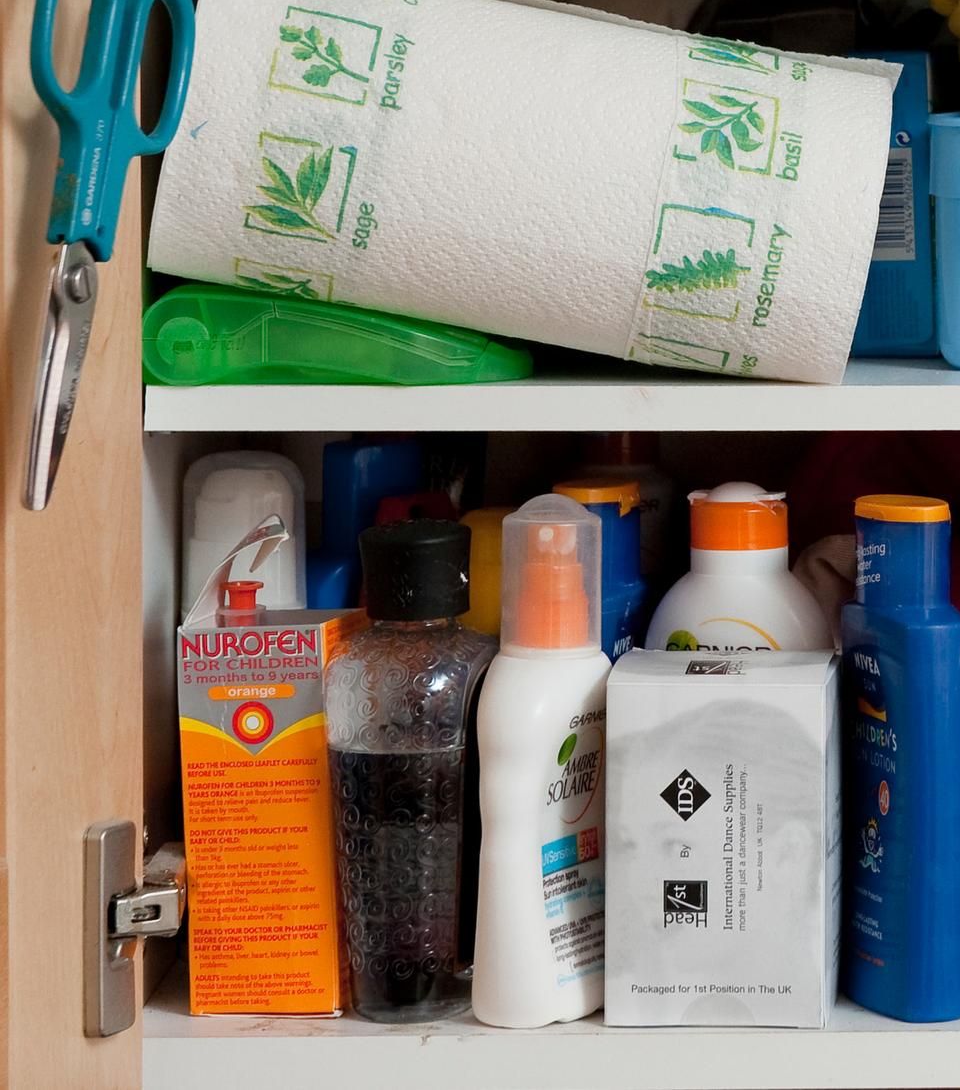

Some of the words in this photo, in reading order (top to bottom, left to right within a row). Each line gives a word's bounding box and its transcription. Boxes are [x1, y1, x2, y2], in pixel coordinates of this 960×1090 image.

[379, 32, 416, 112] parsley
[775, 130, 805, 183] basil
[351, 201, 379, 251] sage
[750, 222, 794, 328] rosemary
[181, 629, 317, 660] NUROFEN
[183, 660, 225, 673] FOR
[226, 656, 319, 671] CHILDREN
[183, 674, 193, 685] 3
[196, 672, 248, 685] months
[251, 672, 265, 683] to
[268, 671, 277, 682] 9
[281, 670, 319, 684] years
[854, 651, 881, 678] NIVEA
[227, 684, 278, 699] orange
[561, 750, 601, 779] AMBRE
[870, 752, 897, 775] LOTION
[546, 769, 596, 806] SOLAIRE
[677, 776, 695, 814] IDS
[722, 763, 737, 814] Supplies
[722, 816, 734, 853] Dance
[737, 812, 746, 859] dancewear
[679, 844, 692, 859] By
[739, 860, 746, 868] a
[737, 869, 749, 887] just
[722, 856, 734, 931] International
[737, 887, 746, 908] than
[663, 911, 708, 929] Head
[738, 909, 746, 932] more
[631, 983, 676, 996] Packaged
[677, 983, 692, 995] for
[693, 984, 707, 995] 1st
[708, 983, 746, 995] Position
[747, 984, 756, 995] in
[757, 984, 776, 995] The
[777, 985, 792, 995] UK
